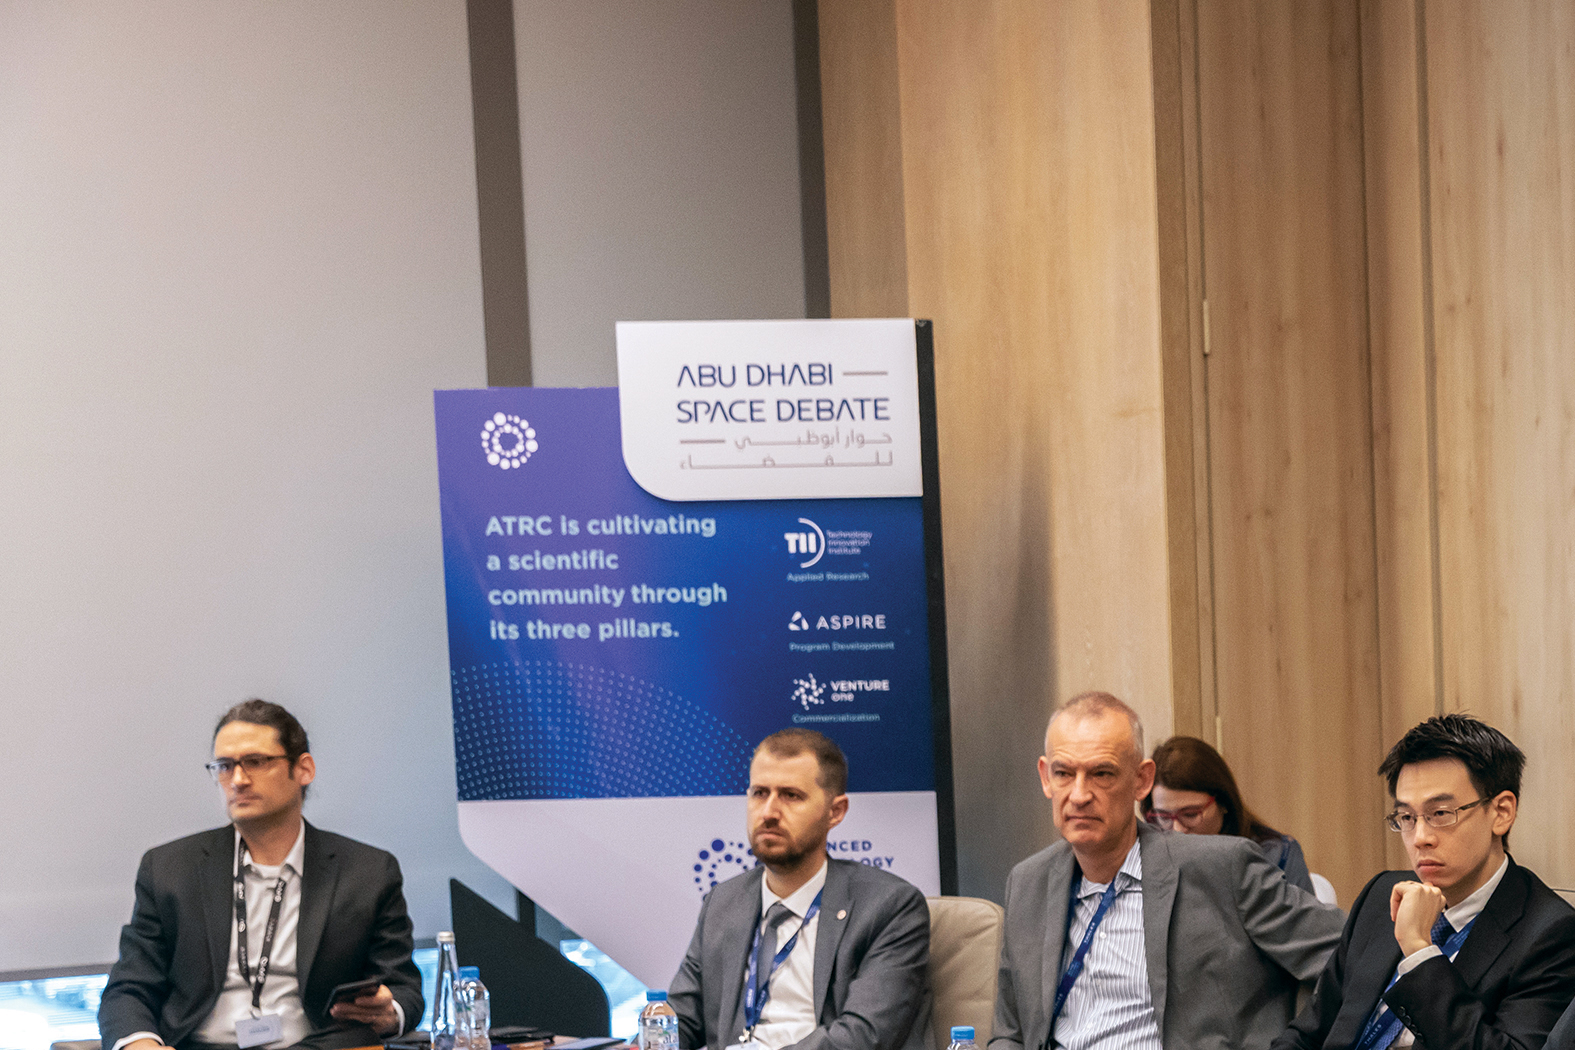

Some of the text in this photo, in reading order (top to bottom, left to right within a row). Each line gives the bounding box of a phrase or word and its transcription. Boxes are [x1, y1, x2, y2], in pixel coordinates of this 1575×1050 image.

[677, 363, 834, 388] ABU DHABI
[677, 397, 891, 423] SPACE DEBATE
[486, 513, 717, 538] ATRC is cultivating
[486, 549, 620, 571] a scientific
[487, 582, 728, 608] community through
[489, 617, 680, 642] its three pillars.
[815, 614, 887, 630] ASPIRE
[830, 679, 890, 692] VENTURE
[827, 840, 872, 852] NCED
[1364, 1023, 1383, 1045] THALES
